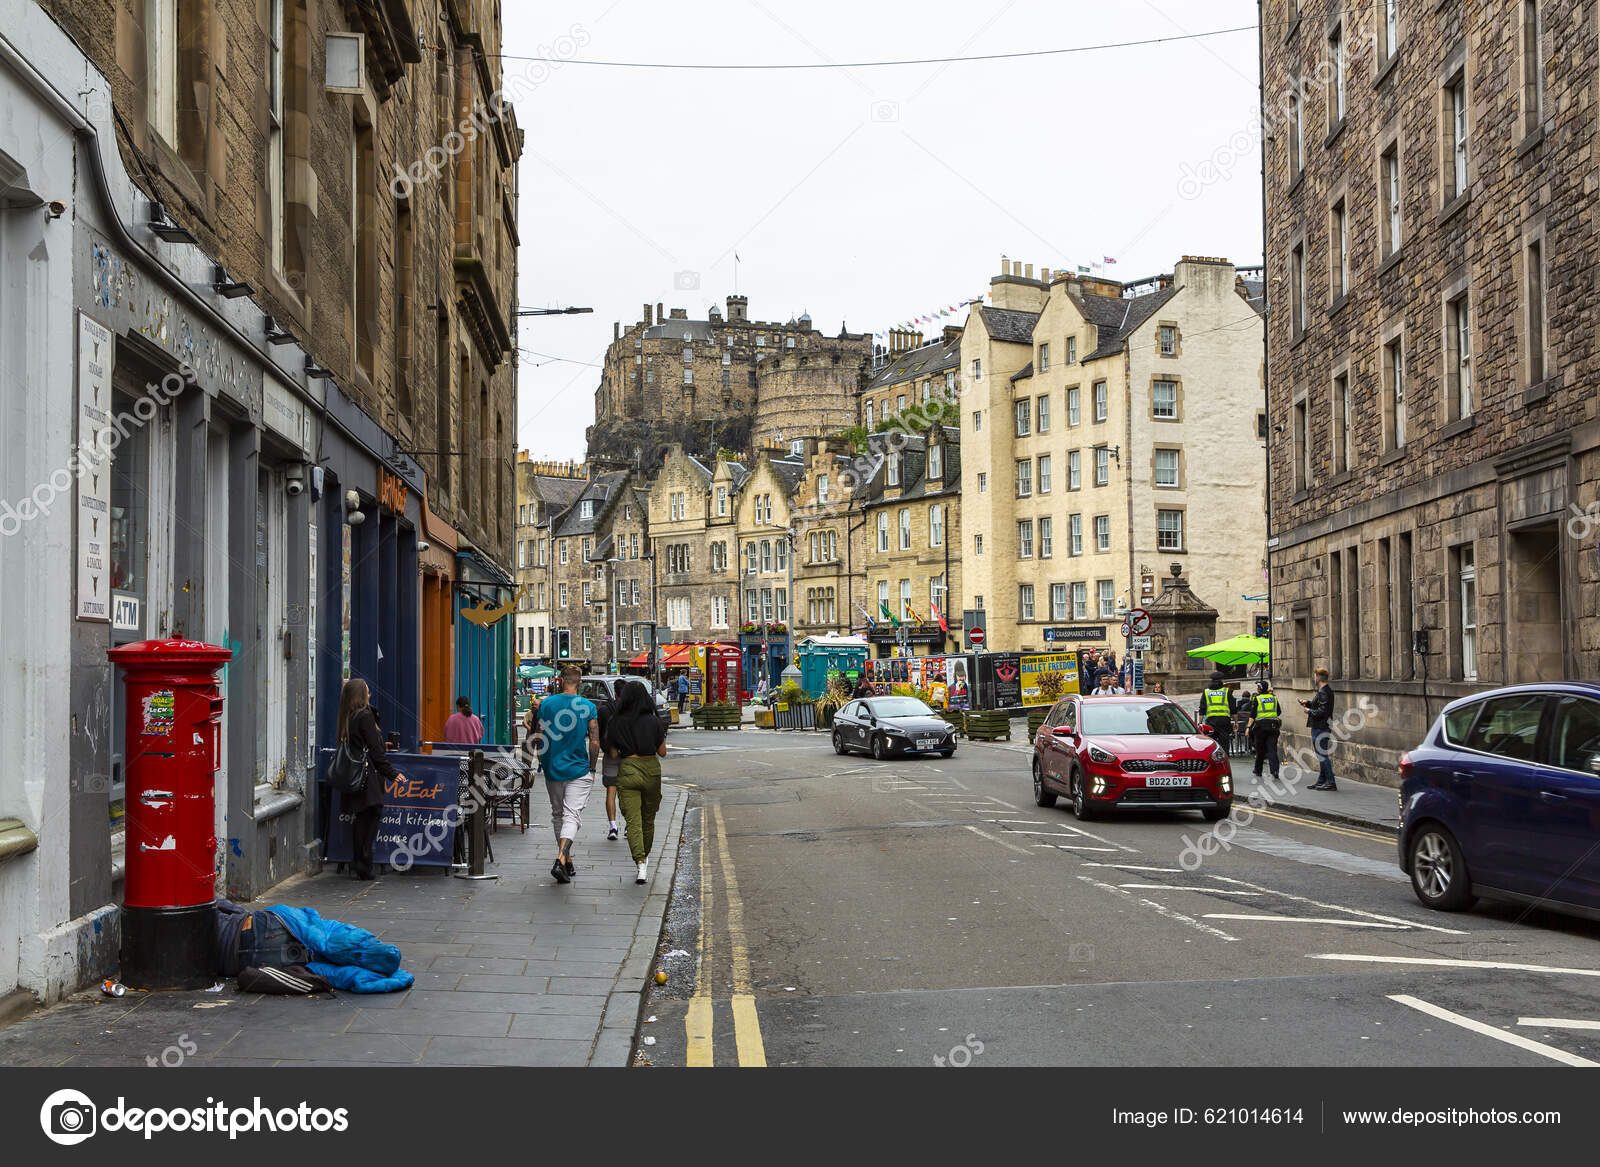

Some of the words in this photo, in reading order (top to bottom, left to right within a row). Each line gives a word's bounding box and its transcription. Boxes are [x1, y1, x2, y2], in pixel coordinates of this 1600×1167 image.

[115, 600, 137, 626] ATM
[1021, 663, 1047, 673] BALLET
[1048, 661, 1077, 671] FREEDOM
[1149, 777, 1171, 786] BD22
[1172, 777, 1189, 786] GYZ
[382, 812, 401, 825] and
[406, 812, 448, 827] kitchen
[376, 830, 408, 843] house
